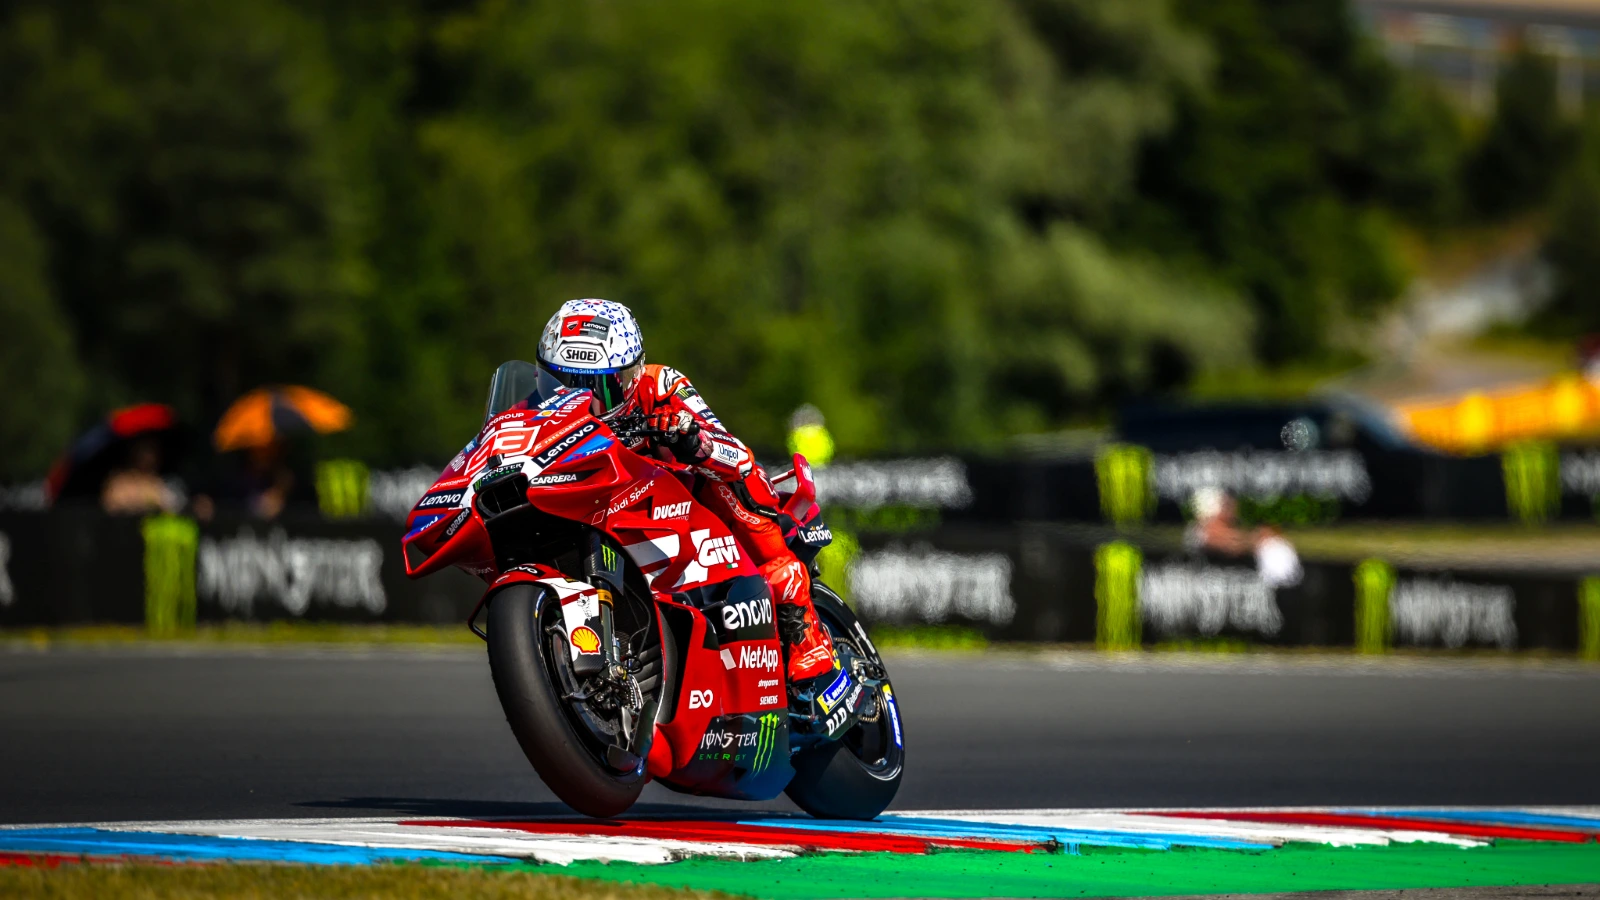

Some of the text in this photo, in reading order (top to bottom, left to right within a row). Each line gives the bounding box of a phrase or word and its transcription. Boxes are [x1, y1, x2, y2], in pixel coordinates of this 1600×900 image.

[583, 321, 607, 331] Lenovo
[565, 348, 598, 362] SHOEI
[536, 424, 595, 465] Lenovo
[718, 444, 739, 461] Unipol
[530, 473, 577, 485] CARRERA
[418, 493, 462, 507] Lenovo
[606, 480, 655, 517] Audi Sport
[652, 500, 692, 520] DUCATI
[446, 507, 470, 537] CARRERA
[800, 528, 832, 543] Lenovo
[698, 535, 741, 567] GIVI
[718, 598, 773, 631] enovo
[738, 644, 779, 673] NetApp
[759, 694, 779, 706] SIEMENS
[698, 753, 747, 761] ENERGY
